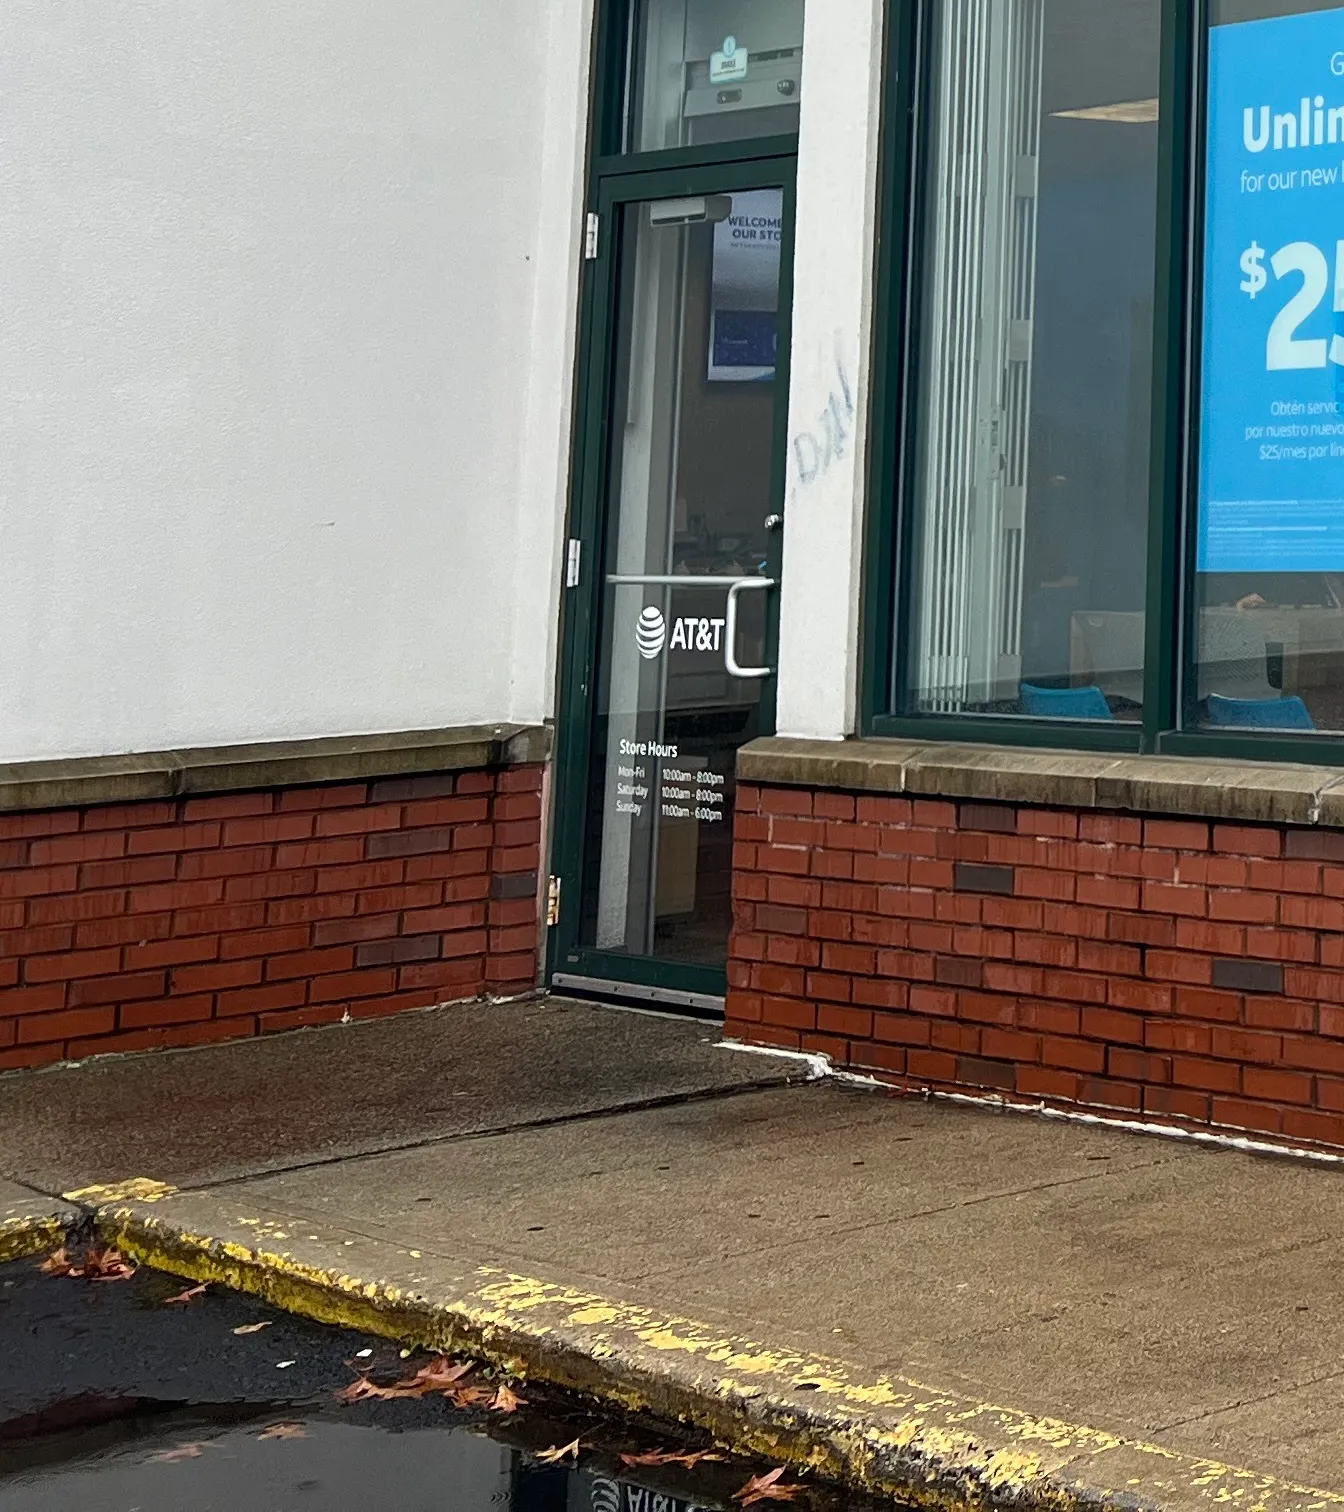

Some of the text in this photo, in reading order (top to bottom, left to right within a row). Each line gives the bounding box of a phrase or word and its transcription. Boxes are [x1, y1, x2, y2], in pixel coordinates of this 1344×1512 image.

[1240, 169, 1265, 194] for
[1267, 170, 1298, 190] our
[1301, 166, 1338, 187] new
[732, 228, 757, 240] OUR
[1245, 427, 1264, 441] por
[1266, 424, 1309, 437] nuestro
[1308, 445, 1328, 461] por
[669, 617, 725, 652] AT&T
[620, 739, 678, 758] Store Hours
[618, 766, 645, 778] Mon-Fri
[662, 768, 692, 781] 10:00am
[696, 771, 724, 787] 8:00pm
[617, 782, 649, 800] Saturday
[661, 786, 691, 799] 10:00am
[695, 789, 724, 804] 8:00pm
[616, 799, 642, 816] Sunday
[661, 804, 690, 818] 11:00am
[694, 807, 722, 823] 6:00pm
